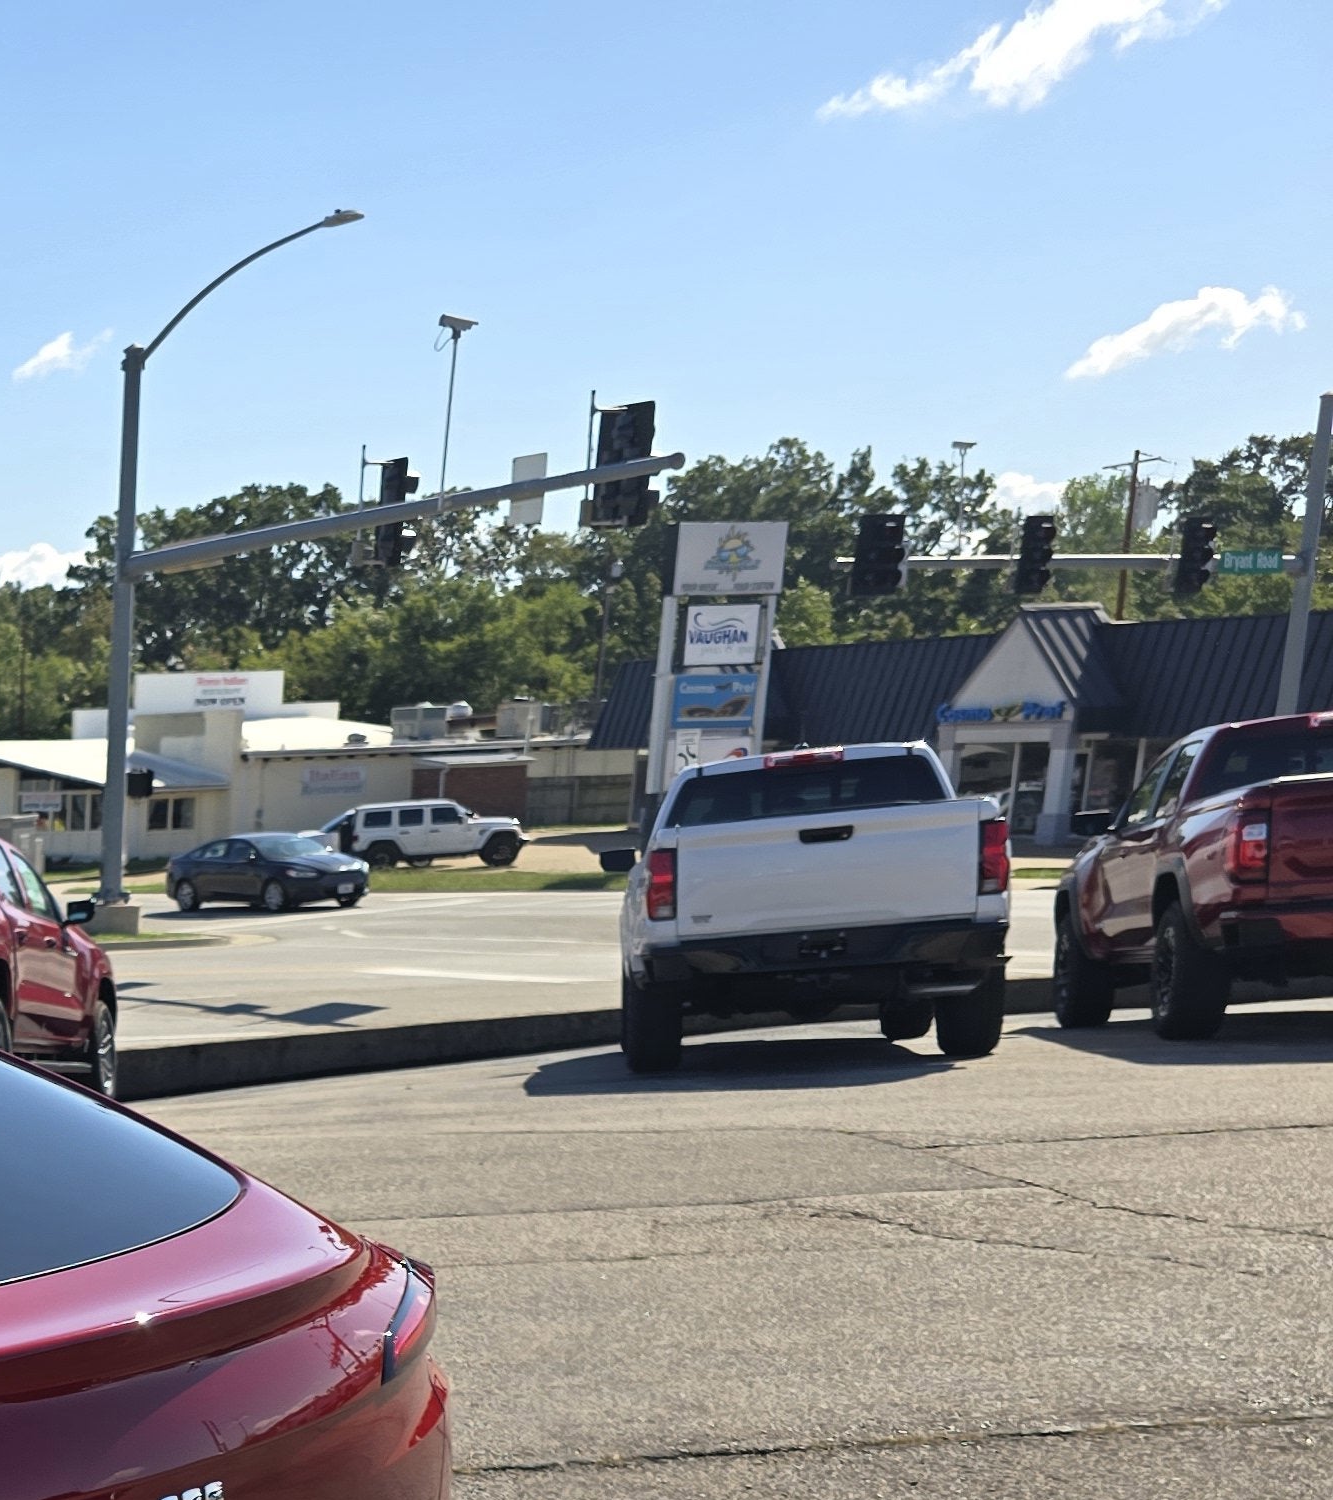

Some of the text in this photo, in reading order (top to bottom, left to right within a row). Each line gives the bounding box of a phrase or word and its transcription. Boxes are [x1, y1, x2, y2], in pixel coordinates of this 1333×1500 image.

[1223, 551, 1279, 572] Bryant Road
[688, 629, 749, 645] VAUGHAN
[732, 681, 755, 693] Prof
[936, 700, 1067, 722] Cosmo Prof
